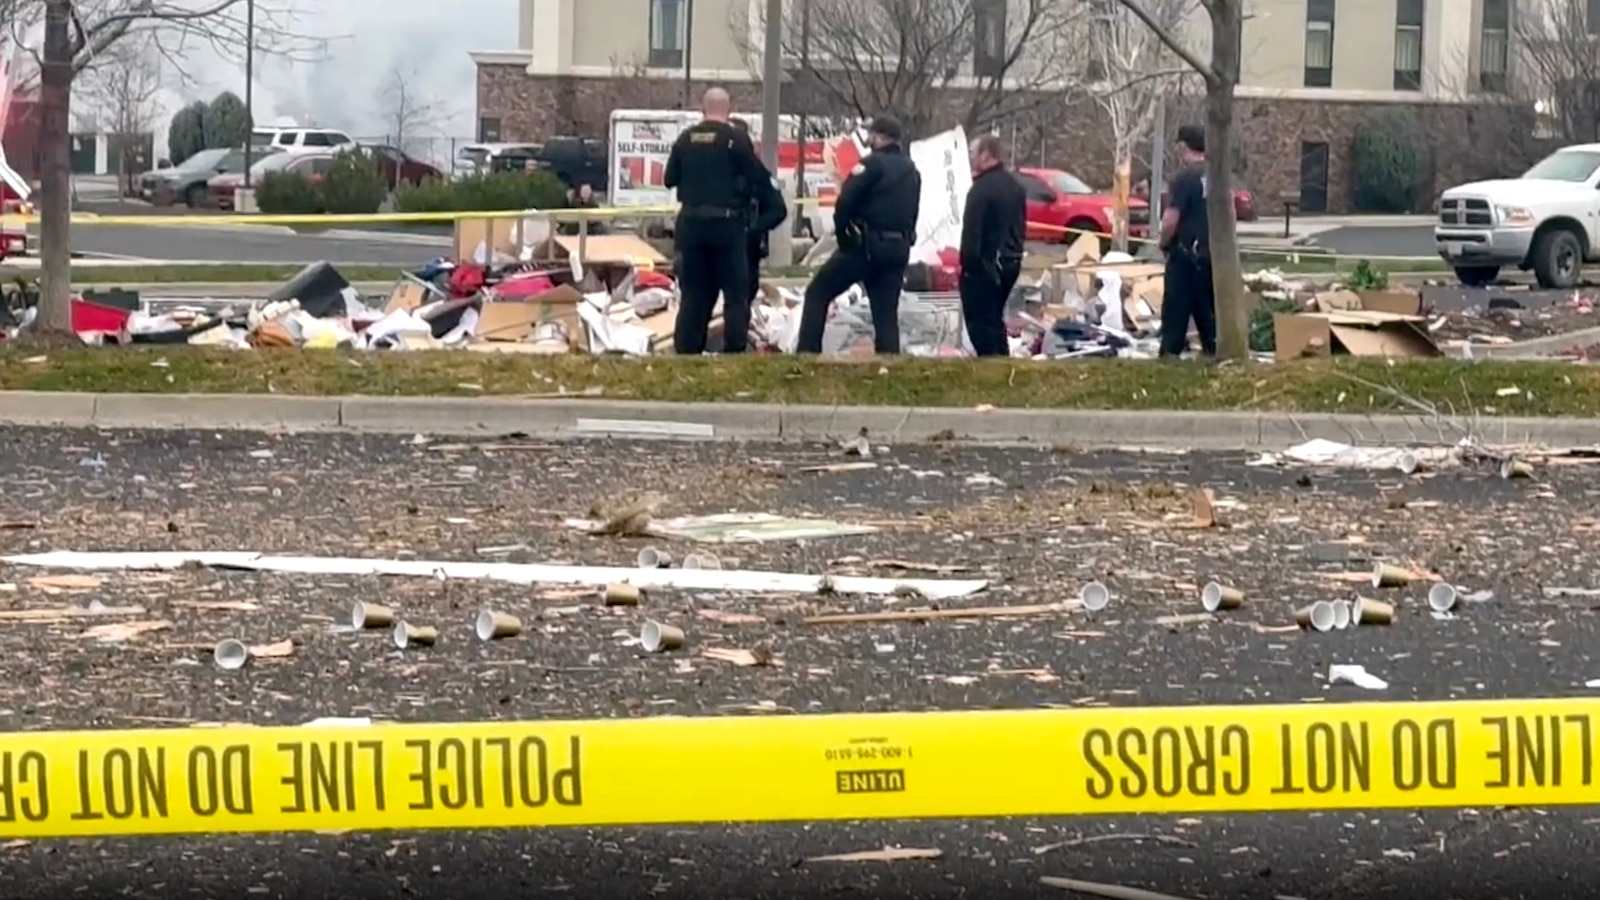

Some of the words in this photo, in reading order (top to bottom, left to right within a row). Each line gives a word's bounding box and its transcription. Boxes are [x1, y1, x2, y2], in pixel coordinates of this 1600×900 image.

[71, 747, 168, 820] NOT
[188, 745, 253, 816] DO
[278, 741, 385, 813] LINE
[406, 736, 582, 809] POLICE
[838, 771, 903, 792] ULINE
[1083, 725, 1250, 799] CROSS
[1271, 722, 1370, 793] NOT
[1393, 719, 1456, 790] DO
[1482, 715, 1592, 787] LINE
